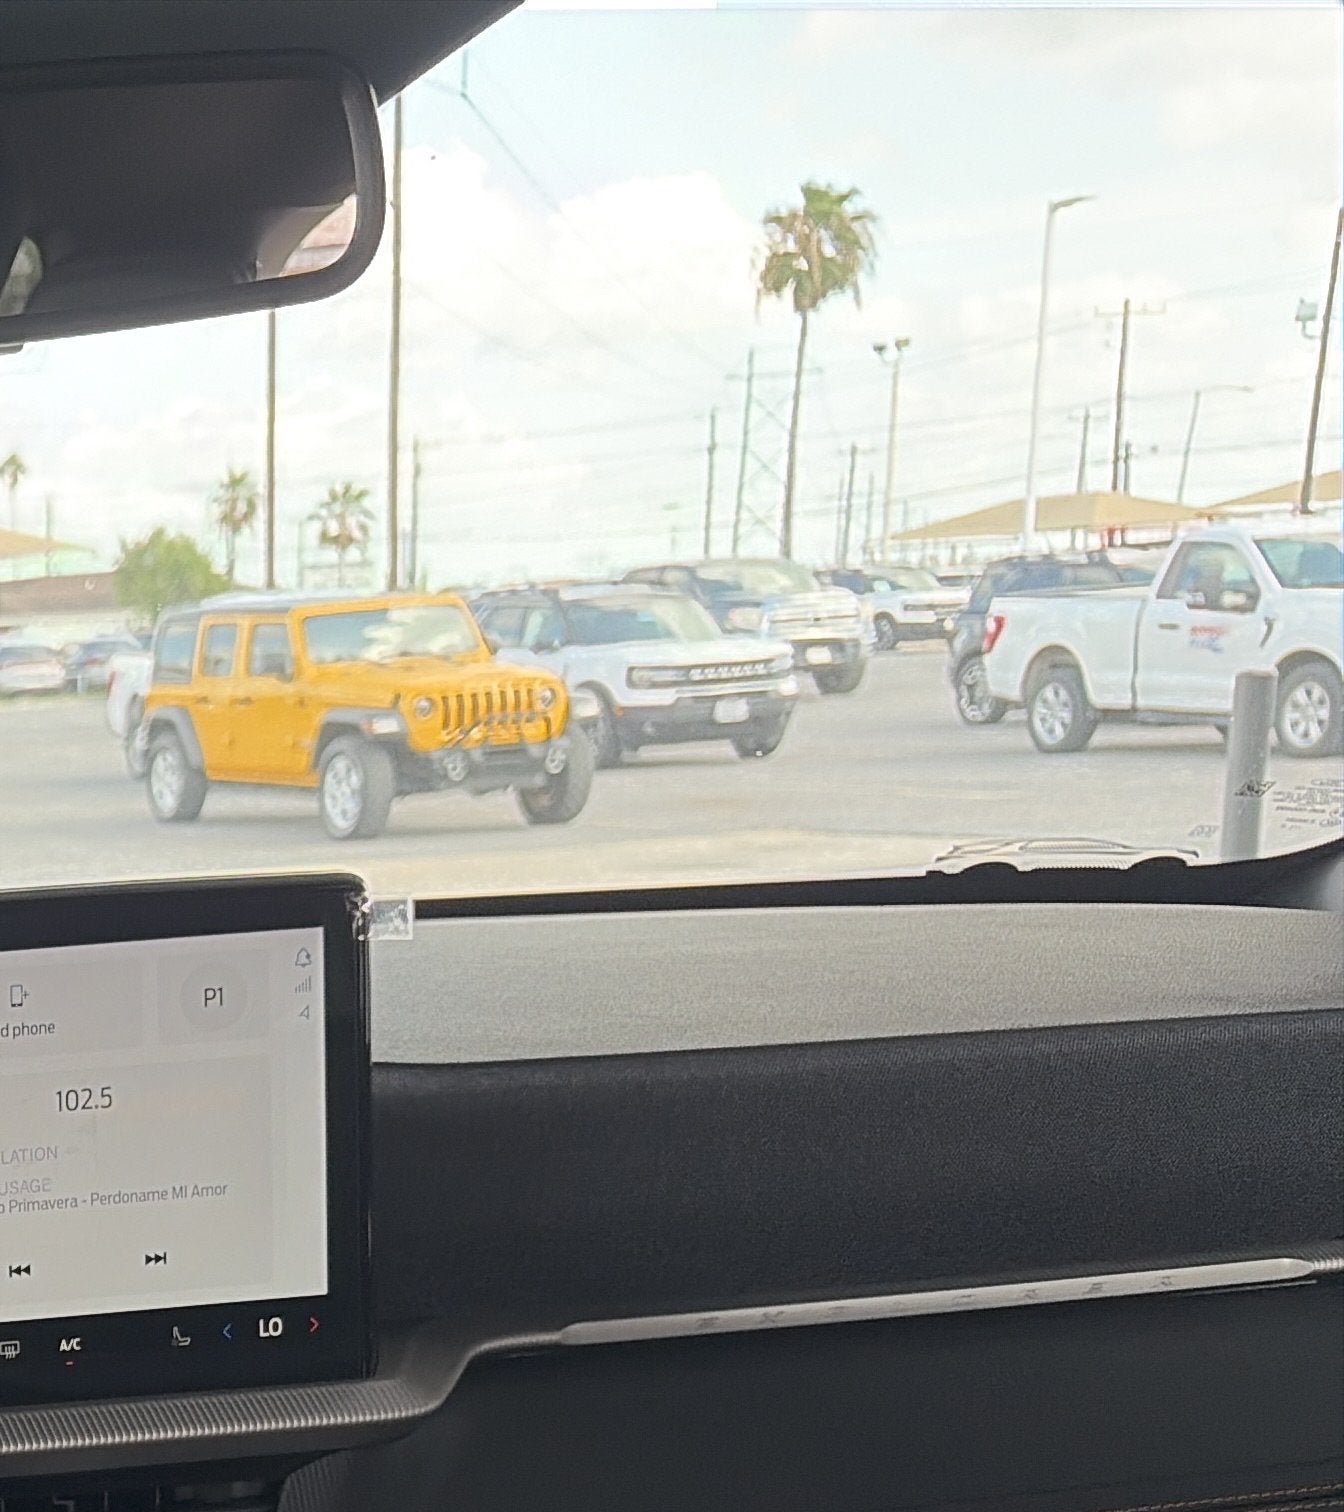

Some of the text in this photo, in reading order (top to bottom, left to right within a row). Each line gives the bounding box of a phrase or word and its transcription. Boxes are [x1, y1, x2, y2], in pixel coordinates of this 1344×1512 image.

[204, 987, 224, 1008] P1
[12, 1021, 56, 1040] phone
[55, 1086, 113, 1113] 102.5
[8, 1196, 79, 1214] Primavera
[90, 1189, 169, 1207] Perdoname
[190, 1183, 229, 1199] Amor
[258, 1316, 283, 1337] LO
[59, 1337, 81, 1352] A/C
